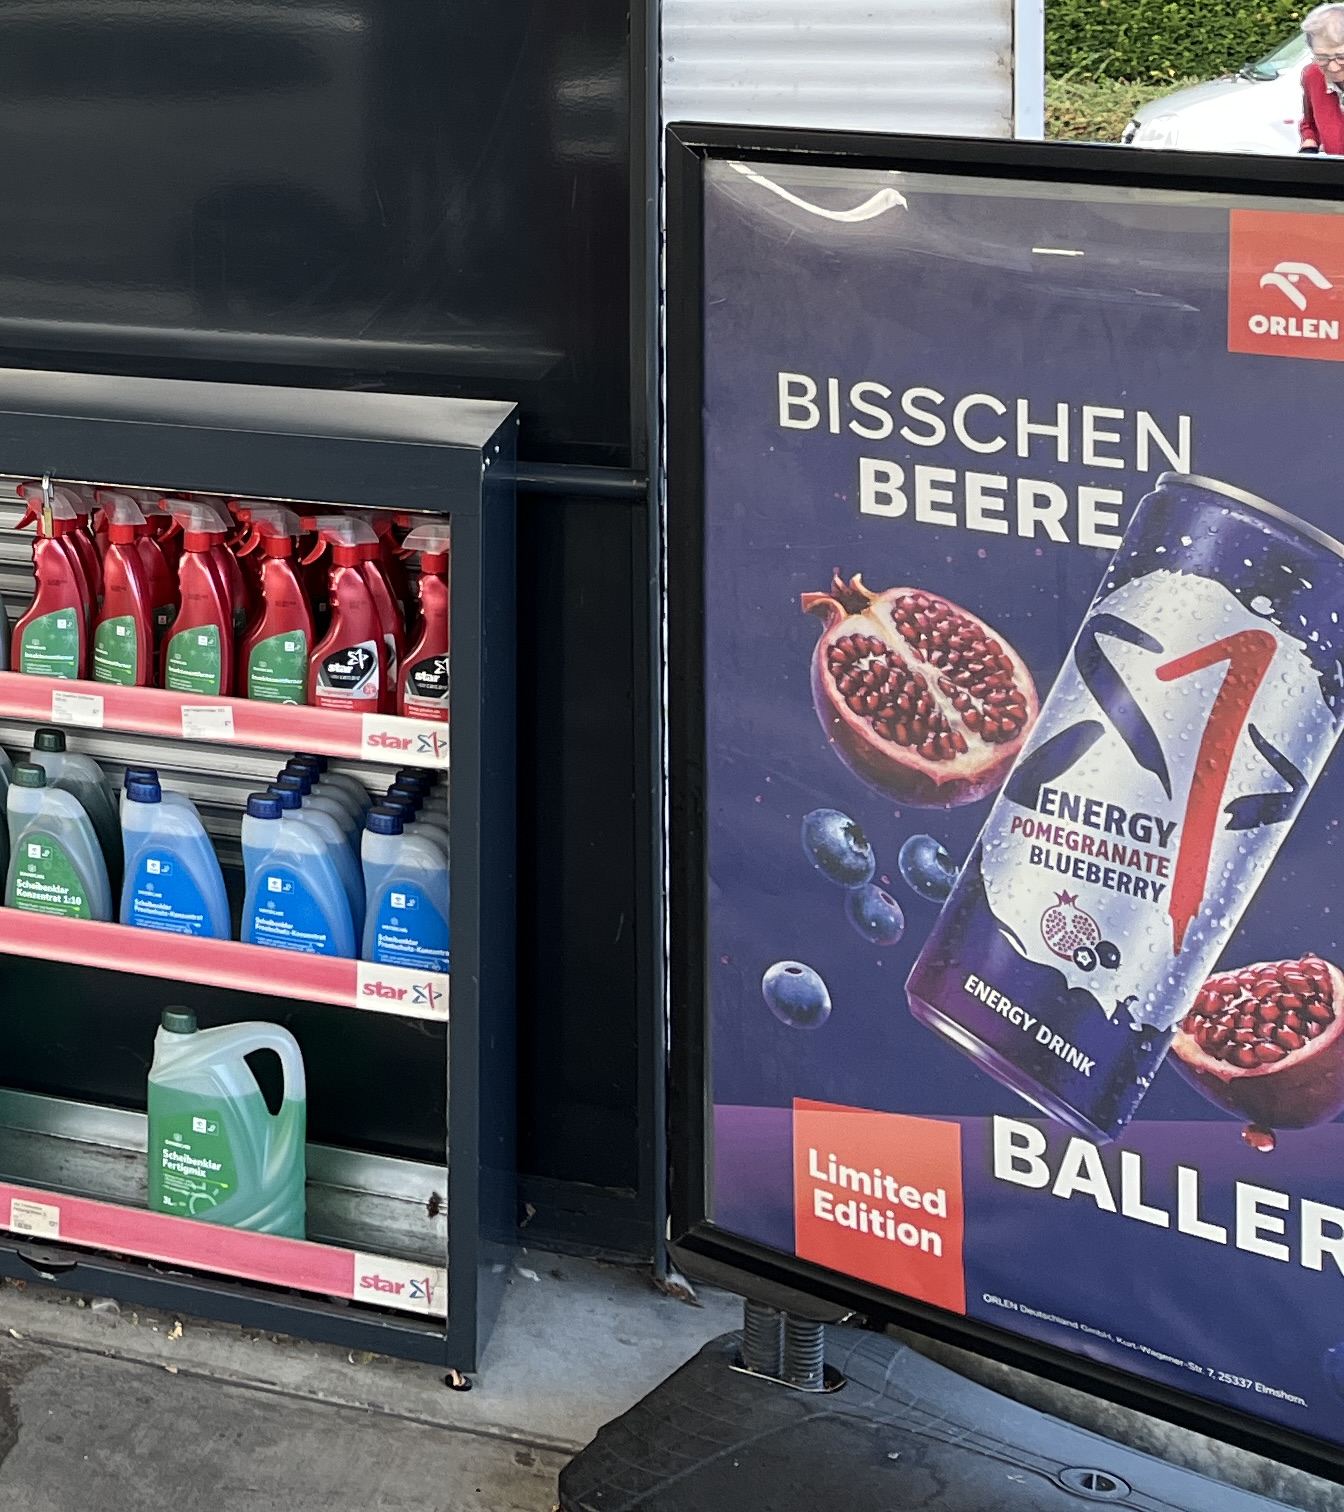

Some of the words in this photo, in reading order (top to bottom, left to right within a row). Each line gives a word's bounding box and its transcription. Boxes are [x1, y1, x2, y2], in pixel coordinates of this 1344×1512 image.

[1247, 314, 1340, 340] ORLEN
[777, 371, 1192, 475] BISSCHEN
[858, 456, 1124, 550] BEERE
[327, 662, 354, 674] star
[414, 671, 441, 683] star
[367, 731, 413, 750] star
[1009, 815, 1171, 880] POMEGRANATE
[1037, 786, 1178, 849] ENERGY
[1028, 844, 1167, 905] BLUEBERRY
[362, 981, 408, 1002] star
[963, 973, 1038, 1042] ENERGY
[1034, 1024, 1097, 1080] DRINK
[807, 1146, 947, 1220] Limited
[812, 1191, 944, 1259] Edition
[359, 1274, 405, 1295] star
[982, 1292, 1019, 1311] ORLEN
[1217, 1371, 1253, 1390] 25337
